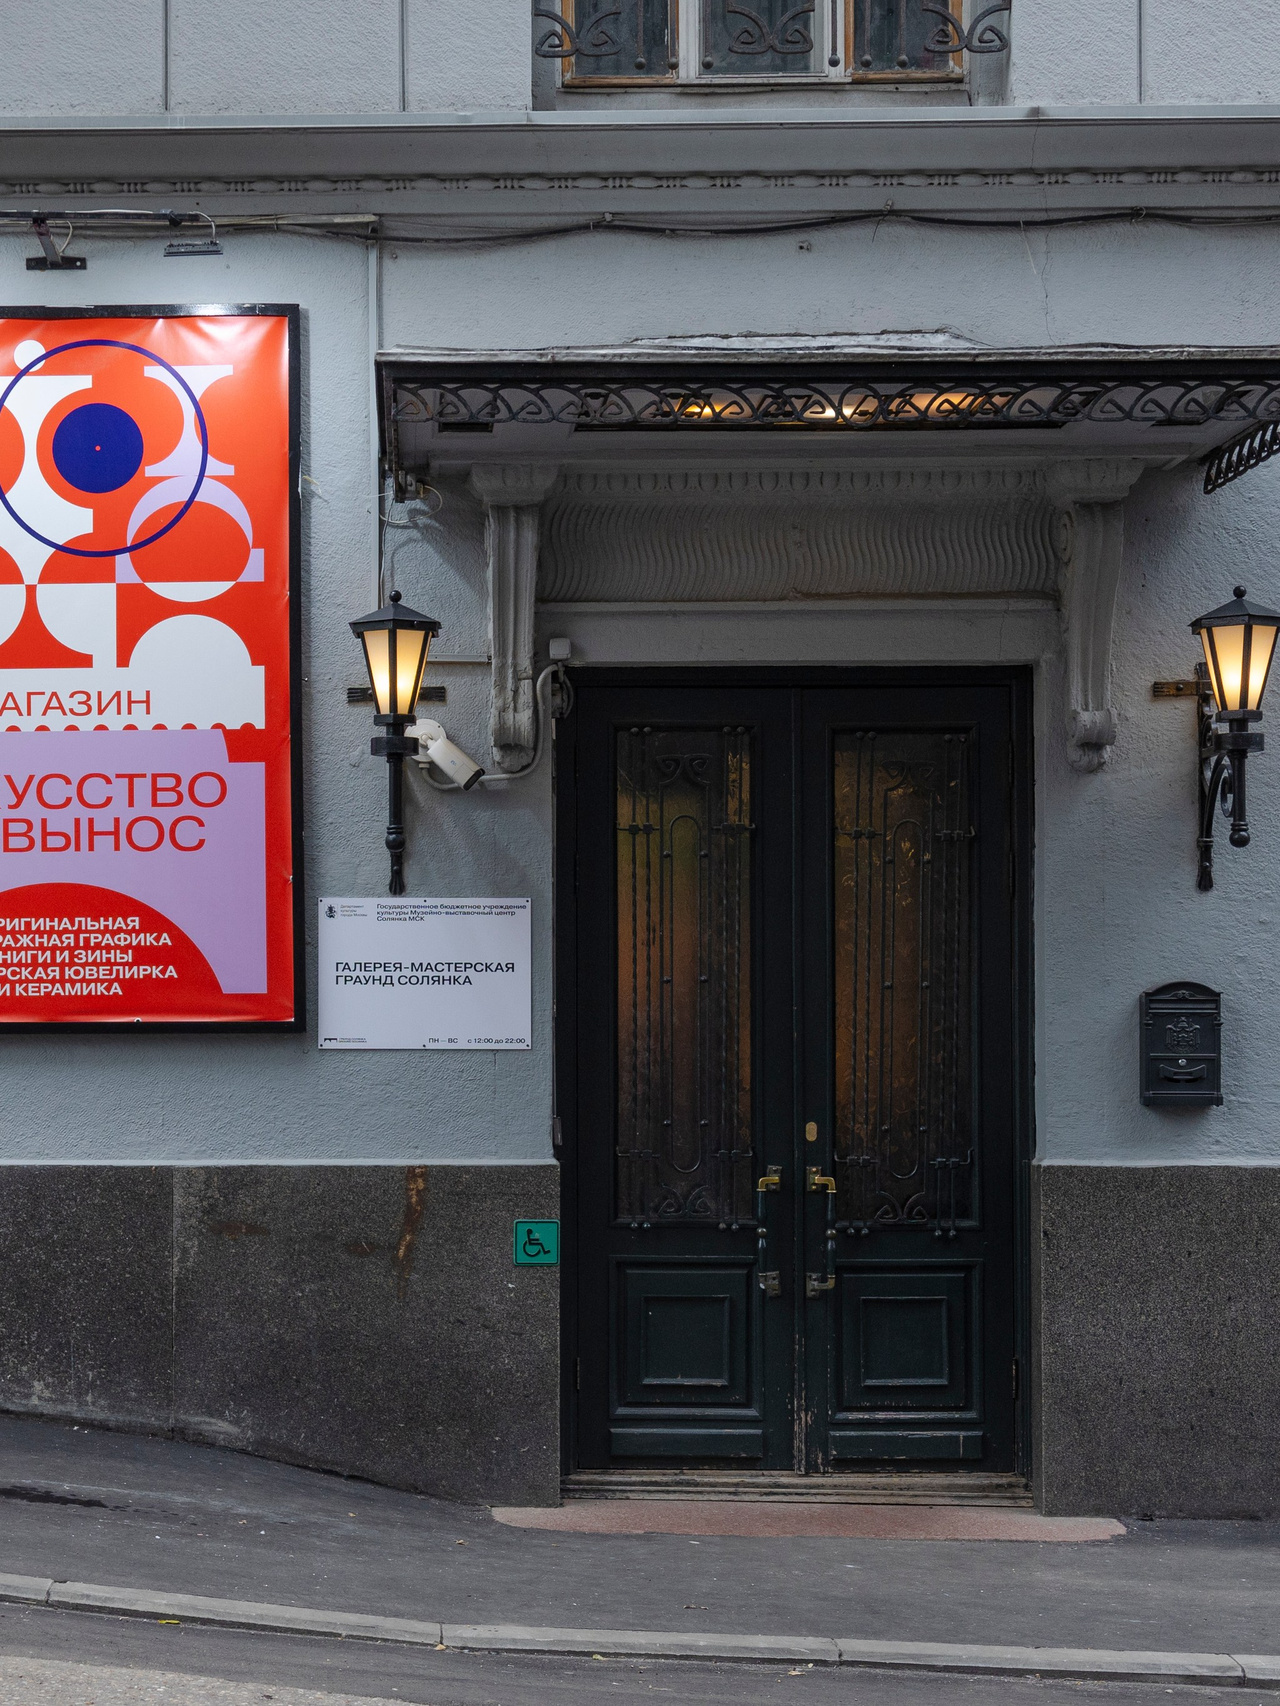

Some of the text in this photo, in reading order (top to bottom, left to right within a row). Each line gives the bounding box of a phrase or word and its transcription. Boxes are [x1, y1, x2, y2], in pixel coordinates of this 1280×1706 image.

[3, 815, 206, 853] ВЫНОС
[79, 932, 172, 947] ГРАФИКА
[55, 950, 69, 963] И
[73, 949, 133, 963] ЗИНЫ
[64, 965, 178, 979] ЮВЕЛИРКА
[335, 962, 515, 973] ГАЛЕРЕЯ-МАСТЕРСКАЯ
[335, 975, 472, 987] ГРАУНД СОЛЯНКА
[15, 982, 123, 996] КЕРАМИКА
